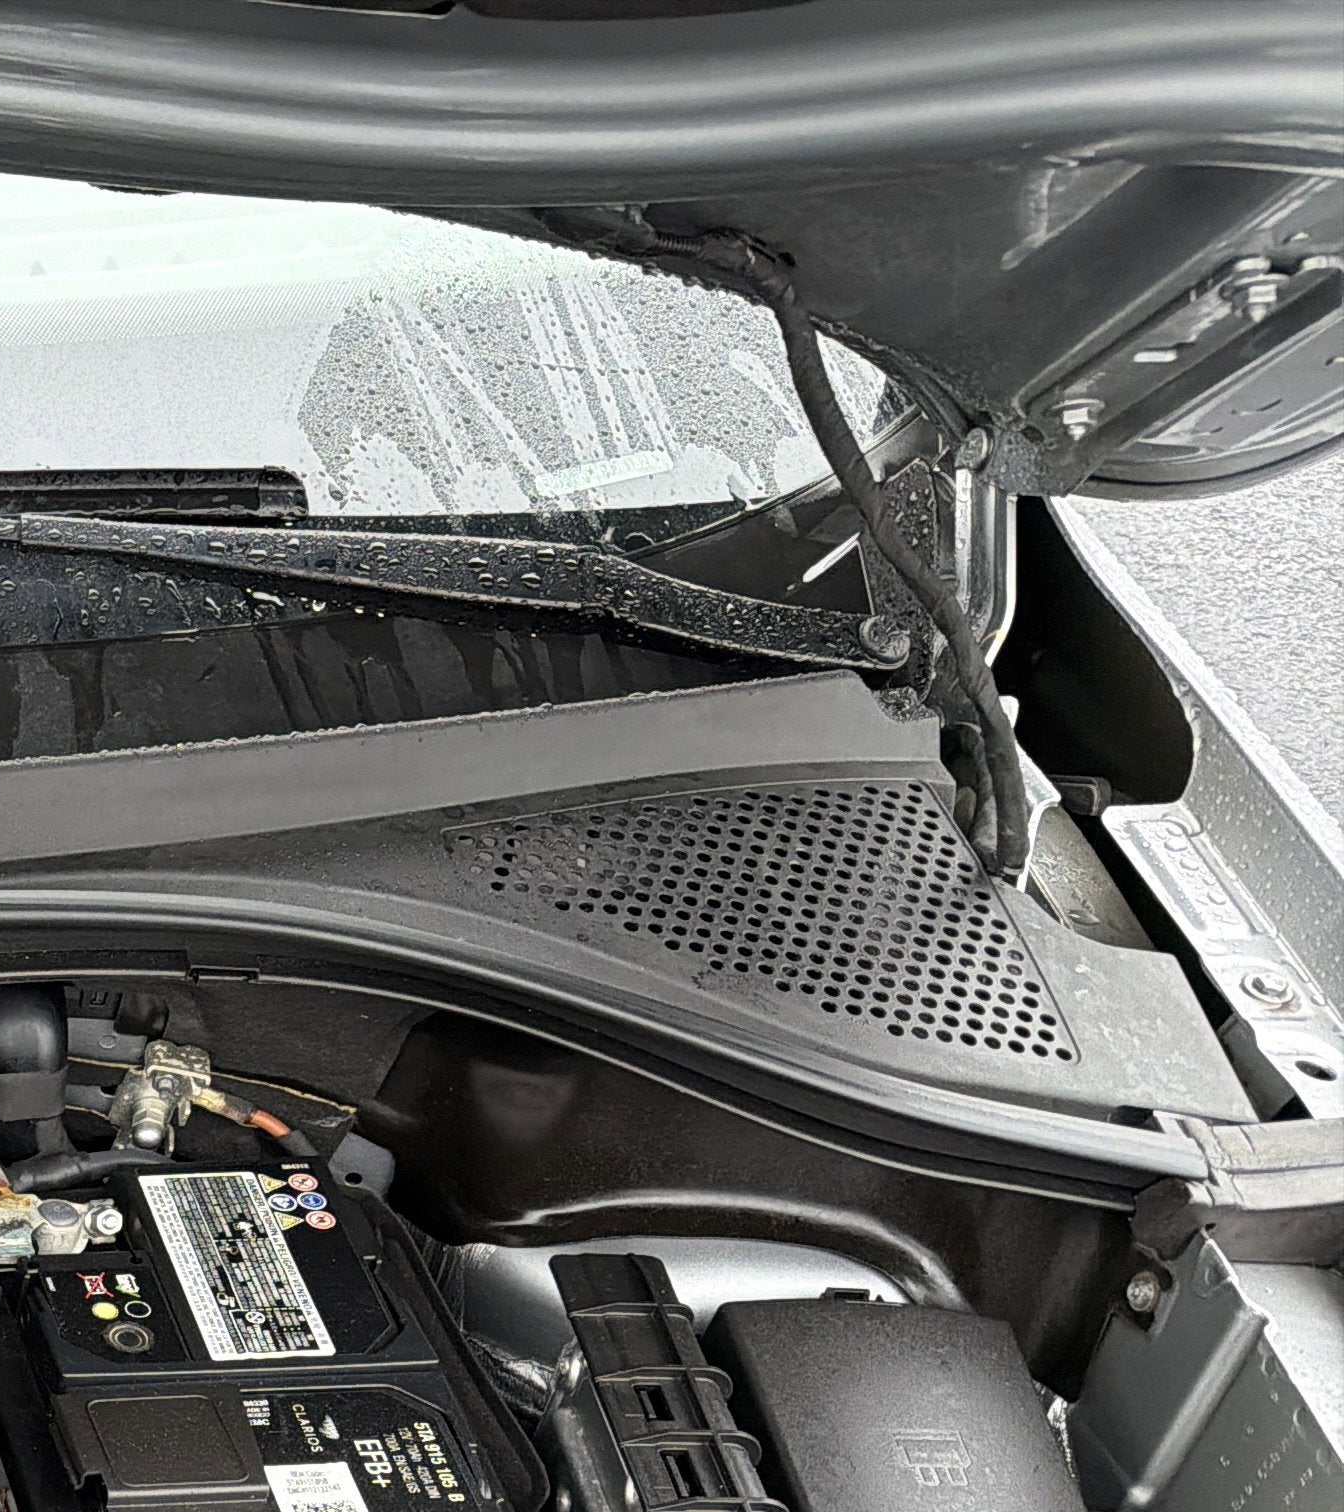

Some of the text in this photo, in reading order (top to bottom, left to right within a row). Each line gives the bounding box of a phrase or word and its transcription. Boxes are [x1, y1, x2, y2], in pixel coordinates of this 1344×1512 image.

[292, 1403, 324, 1453] CLARIOS
[353, 1439, 393, 1488] EFB+
[413, 1422, 466, 1502] 5TA 915 105 B
